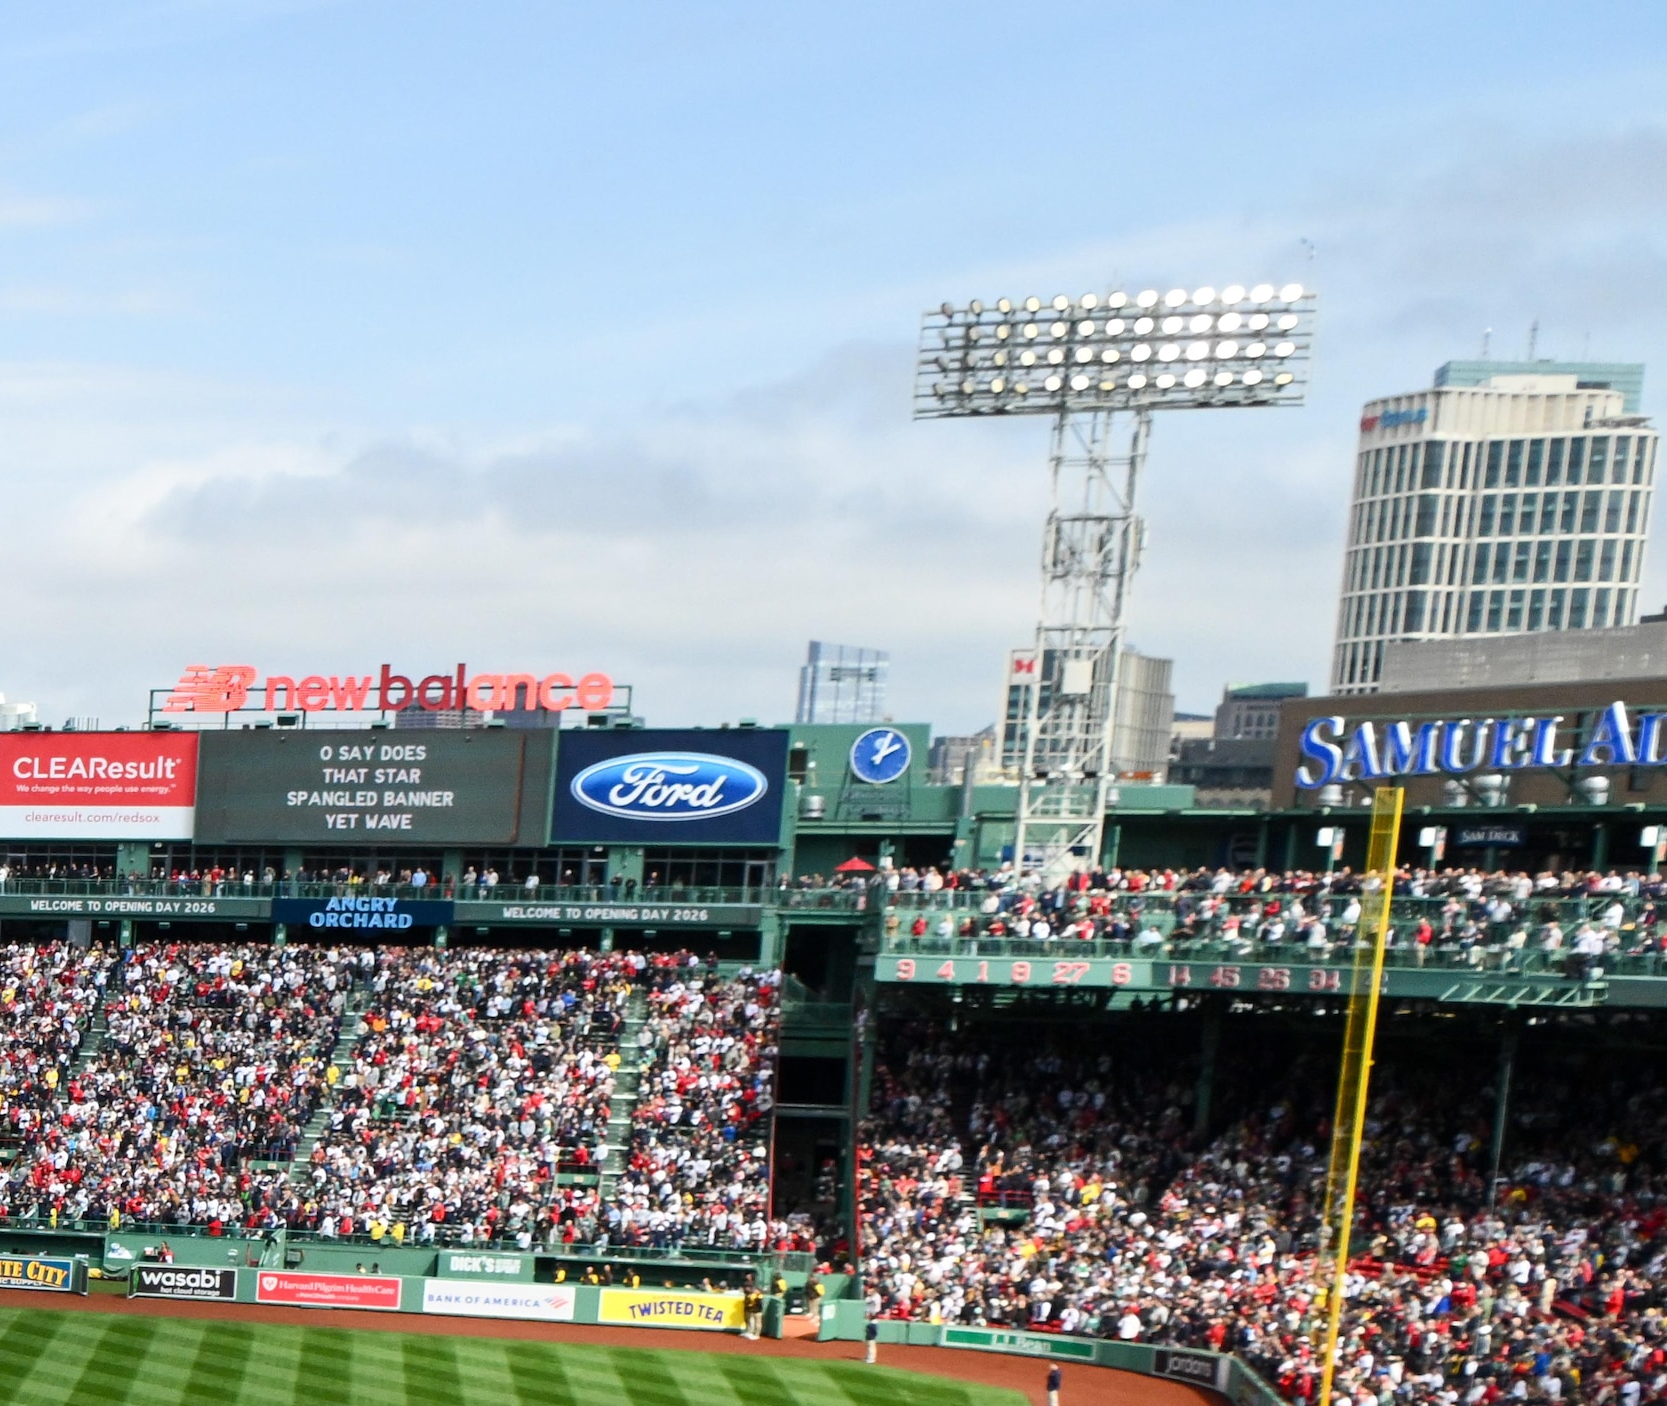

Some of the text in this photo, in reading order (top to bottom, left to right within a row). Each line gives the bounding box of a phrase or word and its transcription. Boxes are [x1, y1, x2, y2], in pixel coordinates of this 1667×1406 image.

[266, 662, 615, 712] new balance
[320, 745, 426, 761] O SAY DOES
[1295, 715, 1574, 790] SAMUEL
[12, 756, 176, 779] CLEAResult
[322, 768, 420, 784] THAT STAR
[31, 784, 60, 795] change
[62, 784, 76, 793] the
[77, 785, 93, 795] way
[94, 784, 123, 795] people
[609, 762, 727, 808] Ford
[287, 791, 454, 807] SPANGLED BANNER
[24, 812, 161, 824] clearesult.com/redsox
[325, 814, 413, 830] YET WAVE
[30, 900, 216, 914] WELCOME TO OPENING DAY 2026
[325, 896, 398, 912] ANGRY
[309, 912, 414, 929] ORCHARD
[503, 906, 708, 921] WELCOME TO OPENING DAY 2026
[895, 959, 916, 980] 9
[936, 960, 957, 981] 4
[977, 961, 988, 982] 1
[1052, 962, 1090, 984] 27
[26, 1259, 69, 1285] CITY
[449, 1255, 495, 1274] DICK'S
[141, 1269, 221, 1289] wasabi
[279, 1279, 313, 1292] Harvard
[313, 1280, 345, 1294] Pilgrim
[193, 1287, 221, 1297] storage
[427, 1293, 541, 1308] BANK OF AMERICA
[628, 1300, 724, 1323] TWISTED TEA
